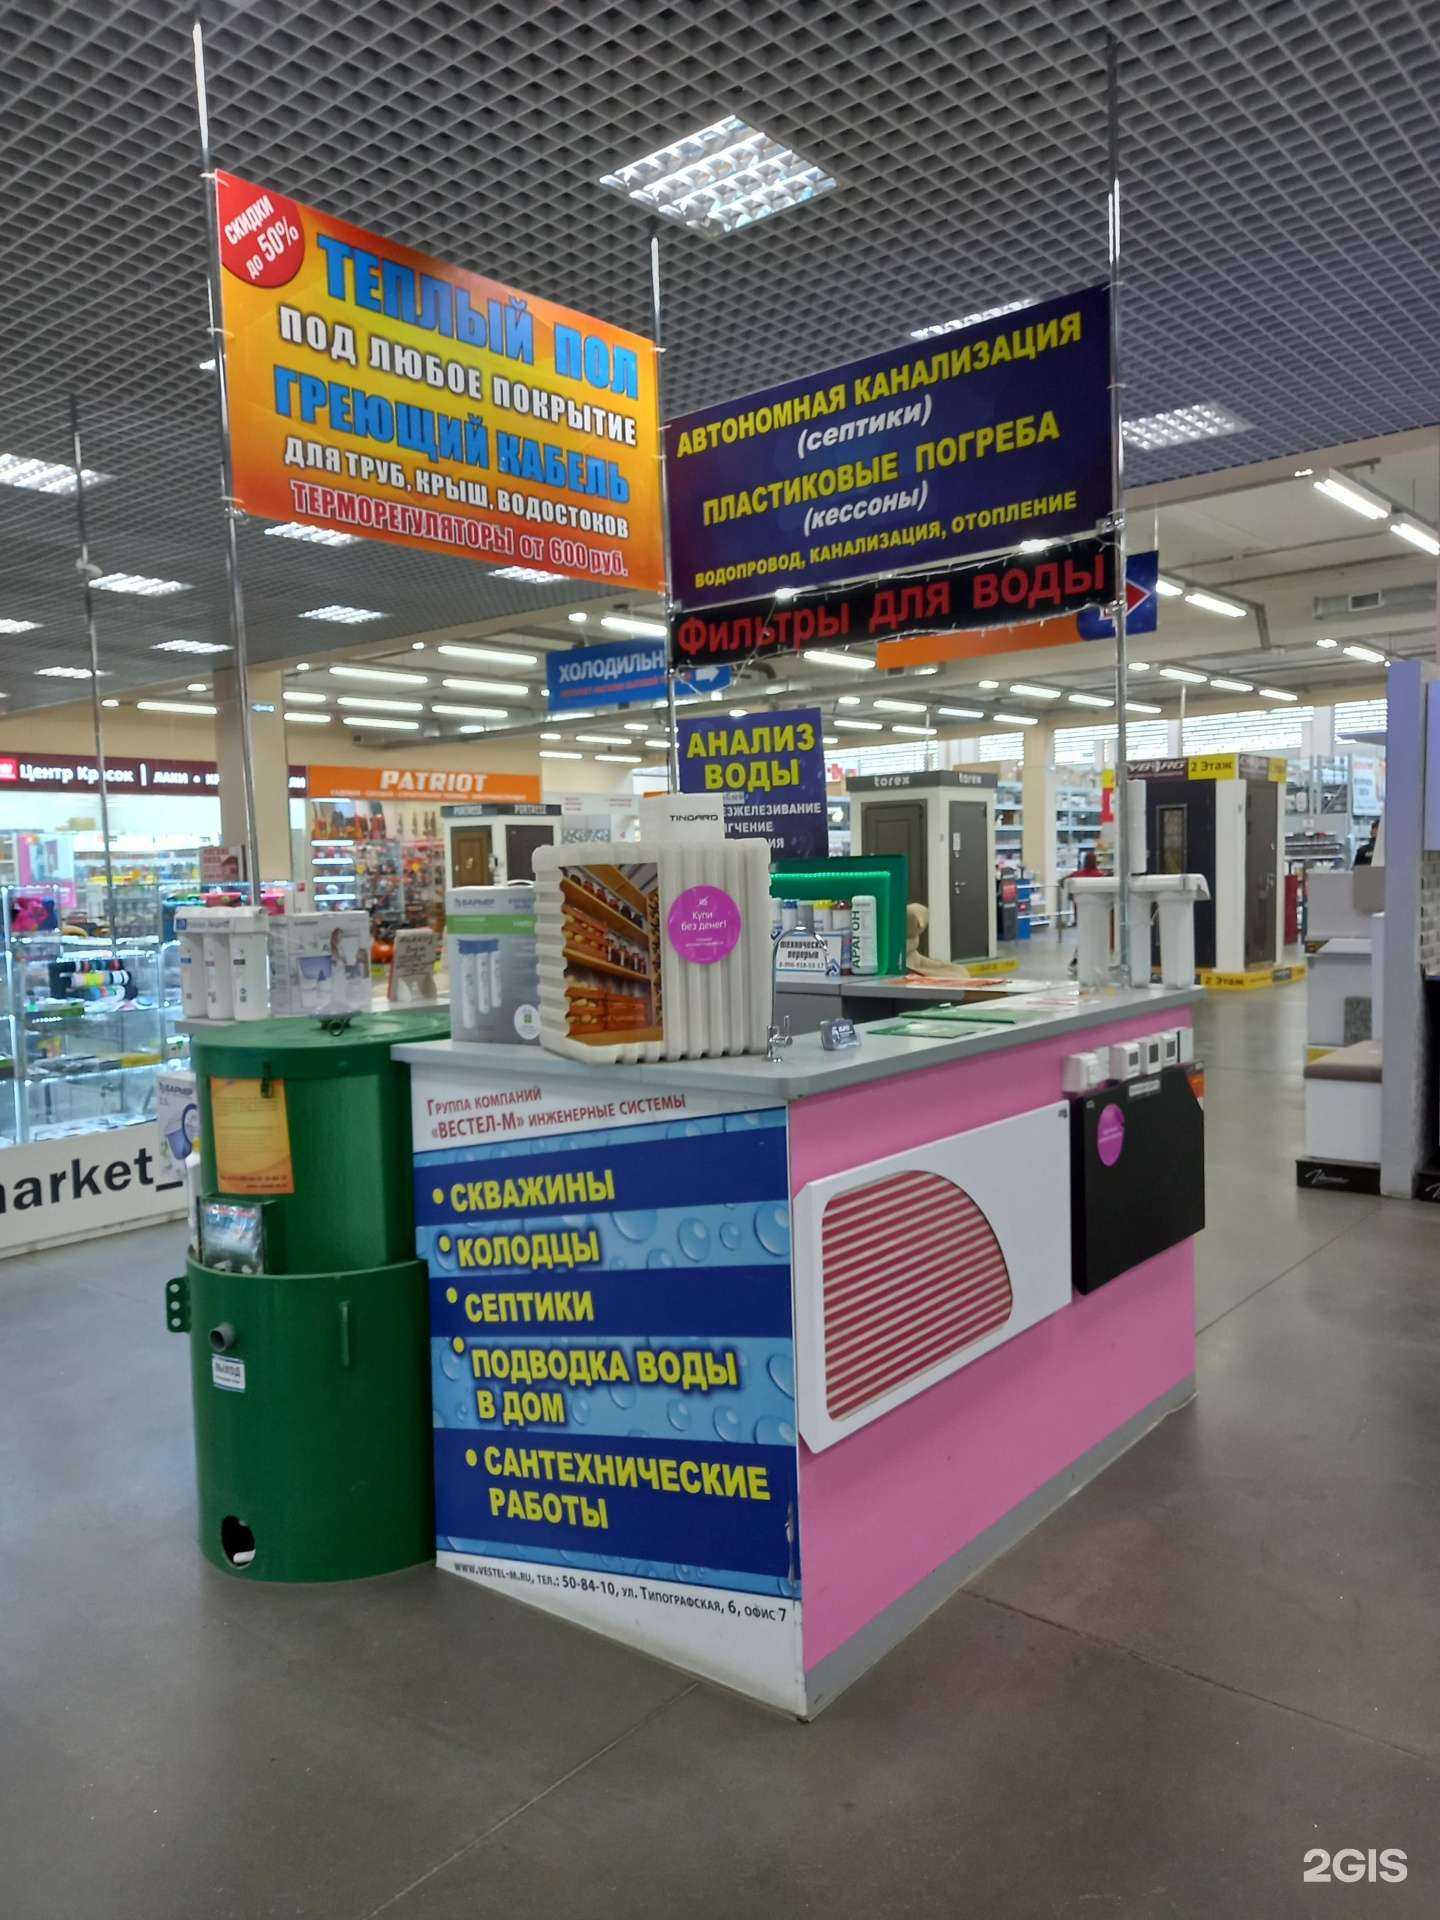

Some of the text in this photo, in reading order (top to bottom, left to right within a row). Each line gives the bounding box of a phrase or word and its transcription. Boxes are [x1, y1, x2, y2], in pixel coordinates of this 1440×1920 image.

[256, 216, 299, 263] 50%
[317, 232, 640, 401] ТЕПЛЫЙ ПОЛ
[278, 304, 638, 447] ПОД ЛЮБОЕ ПОКРЫТИЕ
[676, 311, 1082, 458] АВТОНОМНАЯ КАНАЛИЗАЦИЯ
[273, 365, 631, 504] ГРЕЮЩИЙ КАБЕЛЬ
[796, 393, 932, 459] (септики)
[284, 436, 630, 539] ДЛЯ ТРУБ, КРЫШ, ВОДОСТОКОВ
[702, 410, 1061, 526] ПЛАСТИКОВЫЕ ПОГРЕБА
[290, 480, 514, 555] ТЕРМОРЕГУЛЯТОРЫ
[550, 535, 588, 566] 600
[588, 549, 629, 577] руб.
[803, 479, 929, 537] (кессоны)
[694, 490, 1078, 588] ВОДОПРОВОД, КАНАЛИЗАЦИЯ, ОТОПЛЕНИЕ
[677, 602, 850, 656] Фильтры
[686, 723, 817, 759] АНАЛИЗ
[20, 764, 73, 784] Центр
[380, 770, 487, 793] PATRIOT
[704, 759, 800, 793] ВОДЫ
[873, 775, 910, 788] torex
[1190, 762, 1197, 773] 2
[1200, 760, 1232, 772] Этаж
[431, 1112, 524, 1140] «ВЕСТЕЛ-М»
[0, 1147, 183, 1214] arket_
[450, 1169, 615, 1213] СКВАЖИНЫ
[457, 1231, 600, 1270] КОЛОДЦЫ
[464, 1290, 594, 1323] СЕПТИКИ
[471, 1348, 738, 1391] ПОДВОДКА ВОДЫ
[476, 1390, 565, 1427] В ДОМ
[483, 1446, 771, 1501] САНТЕХНИЧЕСКИЕ
[488, 1487, 609, 1530] РАБОТЫ
[727, 1600, 741, 1617] 6,
[777, 1607, 787, 1623] 7
